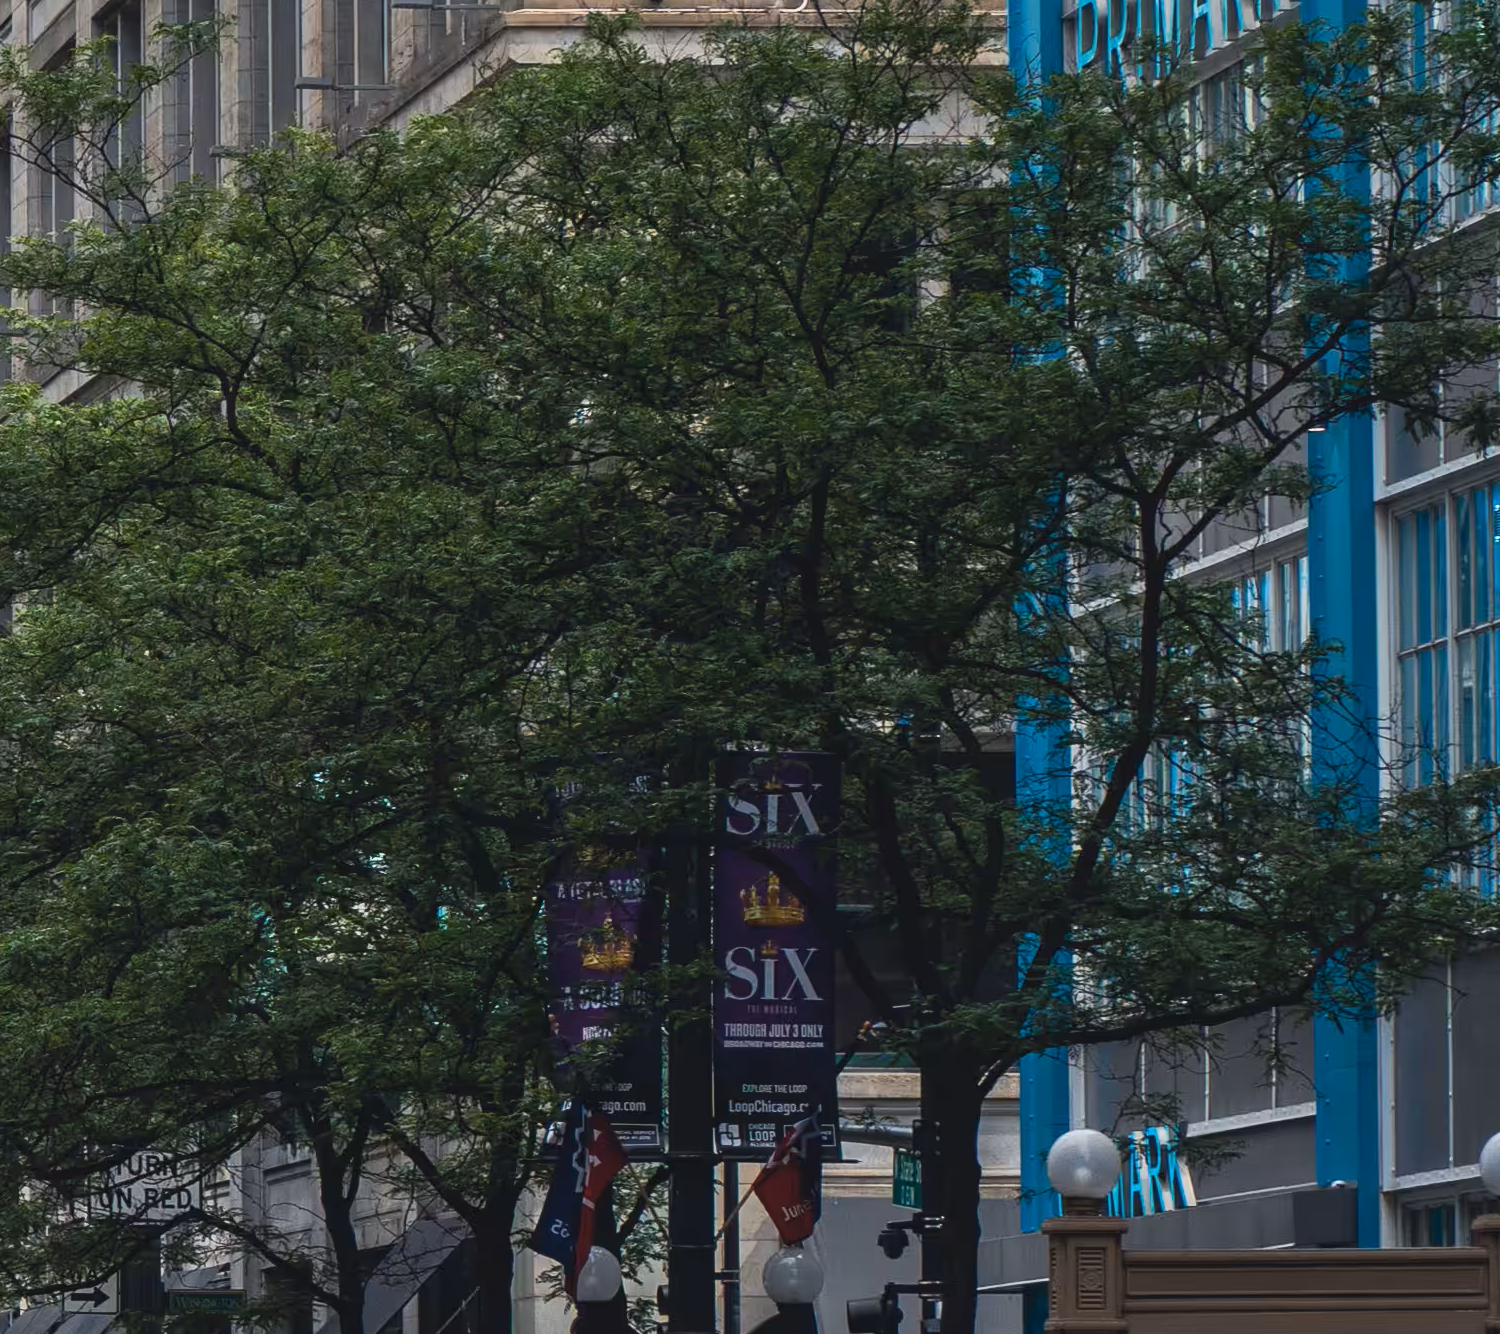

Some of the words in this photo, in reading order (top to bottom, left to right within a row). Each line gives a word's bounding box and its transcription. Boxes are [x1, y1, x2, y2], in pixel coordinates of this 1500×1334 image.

[724, 946, 825, 1001] SIX
[723, 1023, 768, 1038] THROUGH
[769, 1023, 792, 1038] JULY
[792, 1023, 799, 1038] 3
[800, 1023, 824, 1038] ONLY
[742, 1083, 773, 1094] EXPLORE
[774, 1084, 787, 1094] THE
[788, 1084, 808, 1094] LOOP
[729, 1099, 822, 1115] LoopChicago.c
[748, 1130, 776, 1142] LOOP
[145, 1188, 192, 1209] RED
